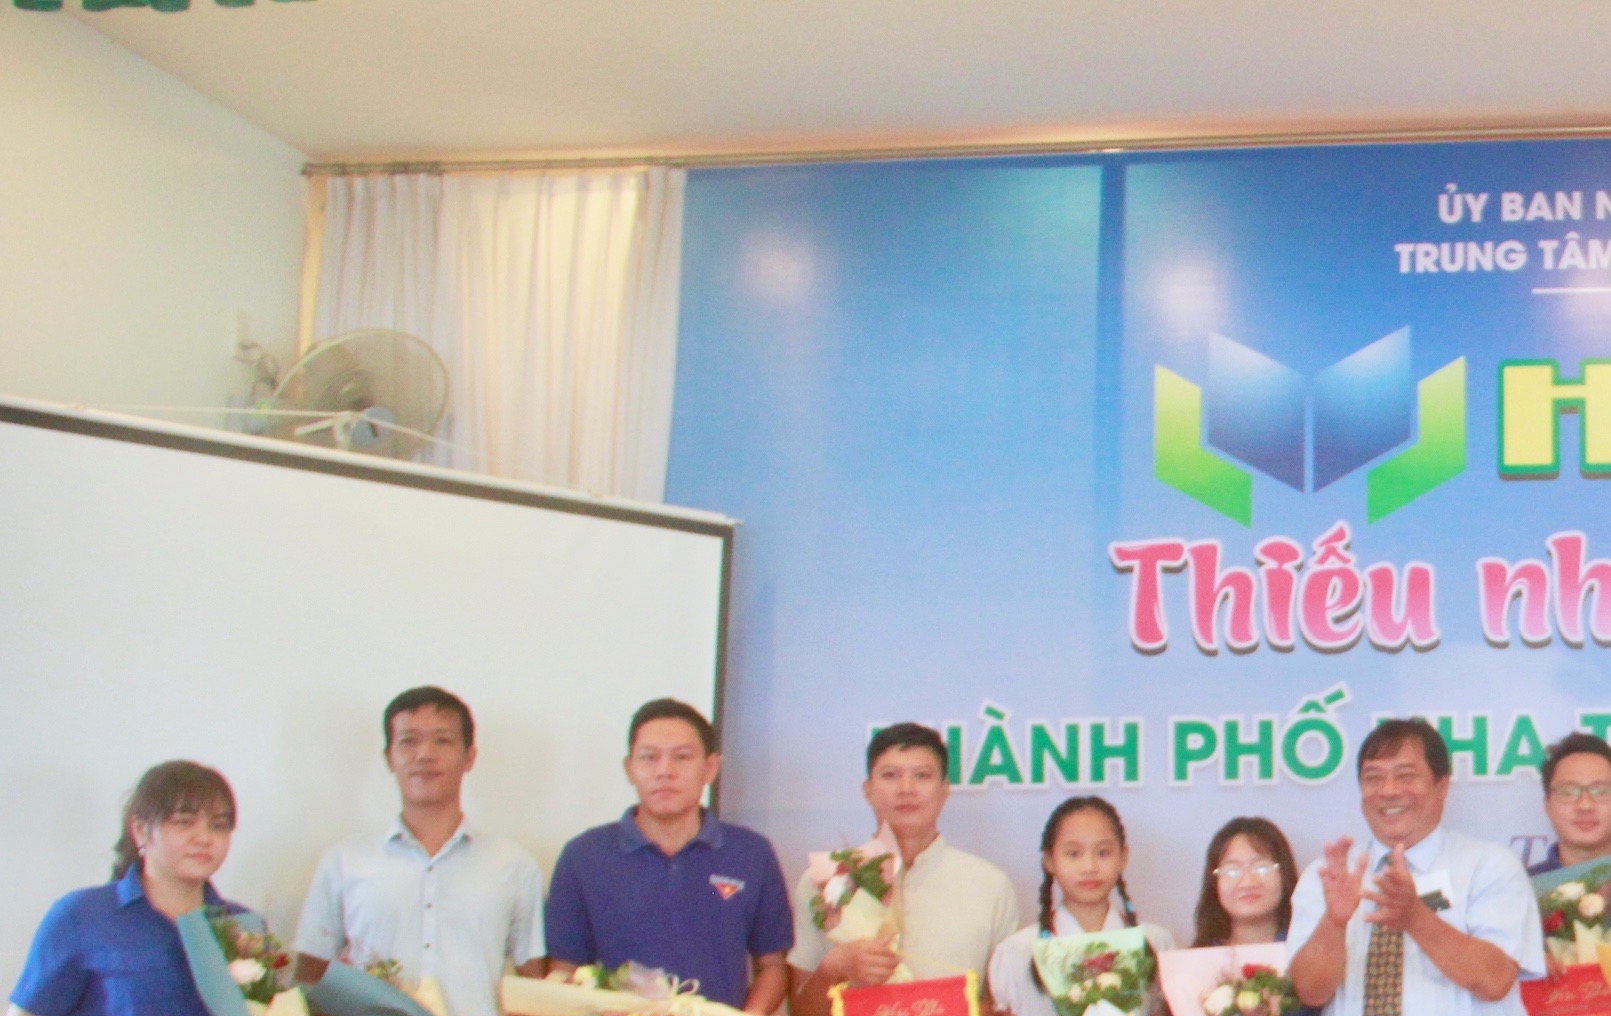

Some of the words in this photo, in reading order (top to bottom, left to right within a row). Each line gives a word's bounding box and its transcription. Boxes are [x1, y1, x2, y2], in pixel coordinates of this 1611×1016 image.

[1438, 183, 1489, 224] ỦY
[1499, 190, 1585, 222] BAN
[1395, 240, 1528, 273] TRUNG
[1110, 521, 1442, 650] Thiếu
[870, 703, 1140, 784] ÀNH
[1172, 686, 1350, 783] PHỐ
[1374, 714, 1546, 777] HA
